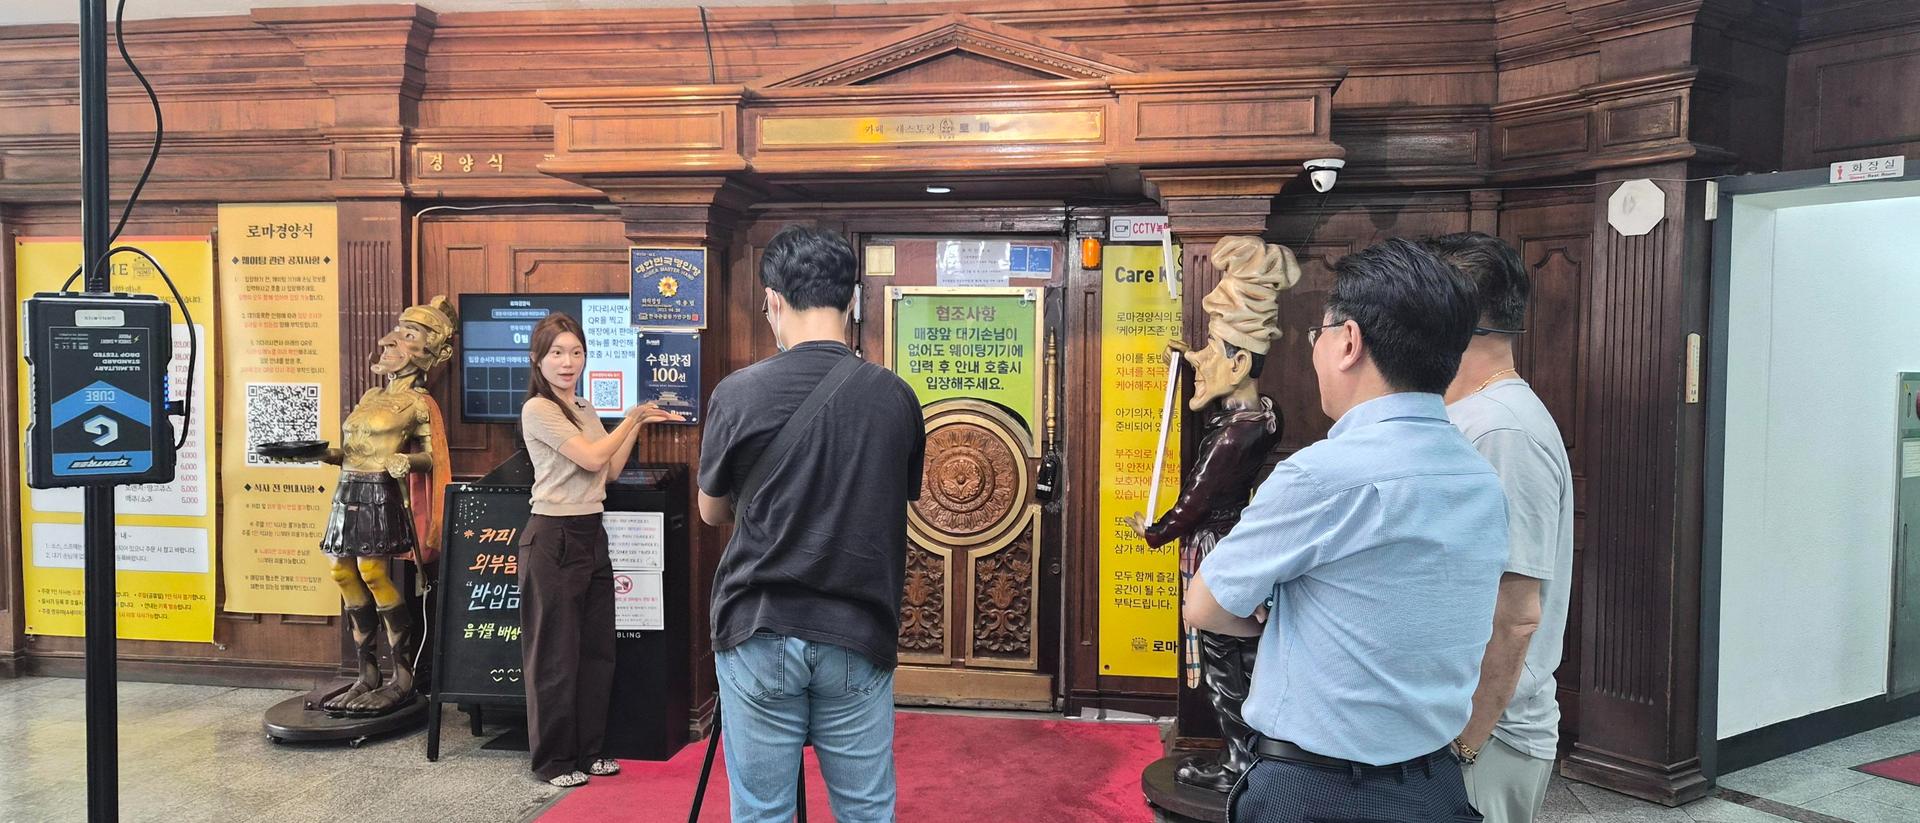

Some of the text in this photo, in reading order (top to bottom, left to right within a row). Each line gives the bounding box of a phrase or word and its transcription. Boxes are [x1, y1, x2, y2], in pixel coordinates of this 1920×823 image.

[430, 152, 502, 172] 경양식
[1852, 159, 1894, 172] 화장실
[246, 224, 313, 239] 로마경양식
[242, 256, 320, 265] 웨이팅 관련 공지사항
[636, 256, 701, 277] 대한민국명인장
[1115, 266, 1154, 282] Care
[936, 305, 996, 322] 협조사항
[1117, 312, 1172, 323] 로마경양식의
[588, 316, 606, 325] QR을
[588, 327, 617, 336] 매장에서
[914, 328, 1018, 341] 매장앞 대기손님이
[1117, 326, 1182, 336] '케어키즈존' 입
[908, 344, 1024, 358] 없어도 웨이팅기기에
[645, 353, 691, 367] 수원맛집
[1116, 353, 1143, 364] 아이를
[910, 360, 1022, 374] 입력 후 안내 호출시
[1116, 367, 1143, 378] 자녀를
[652, 368, 686, 382] 100선
[926, 377, 1005, 391] 입장해주세요.
[85, 390, 115, 402] CUBE
[1116, 408, 1154, 420] 아기의자,
[1116, 421, 1152, 432] 준비되어
[1115, 448, 1152, 459] 부주의로
[1115, 462, 1154, 474] 및 안전사
[1115, 476, 1152, 487] 보호자에
[255, 484, 315, 494] 식사 전 안내사항
[479, 528, 516, 546] 커피
[1114, 544, 1145, 555] 삼가 해
[1115, 572, 1175, 584] 모두 함께 즐길
[1114, 584, 1141, 596] 공간이
[1156, 586, 1165, 596] 수
[1114, 598, 1172, 610] 부탁드립니다.
[464, 623, 495, 640] 음식물
